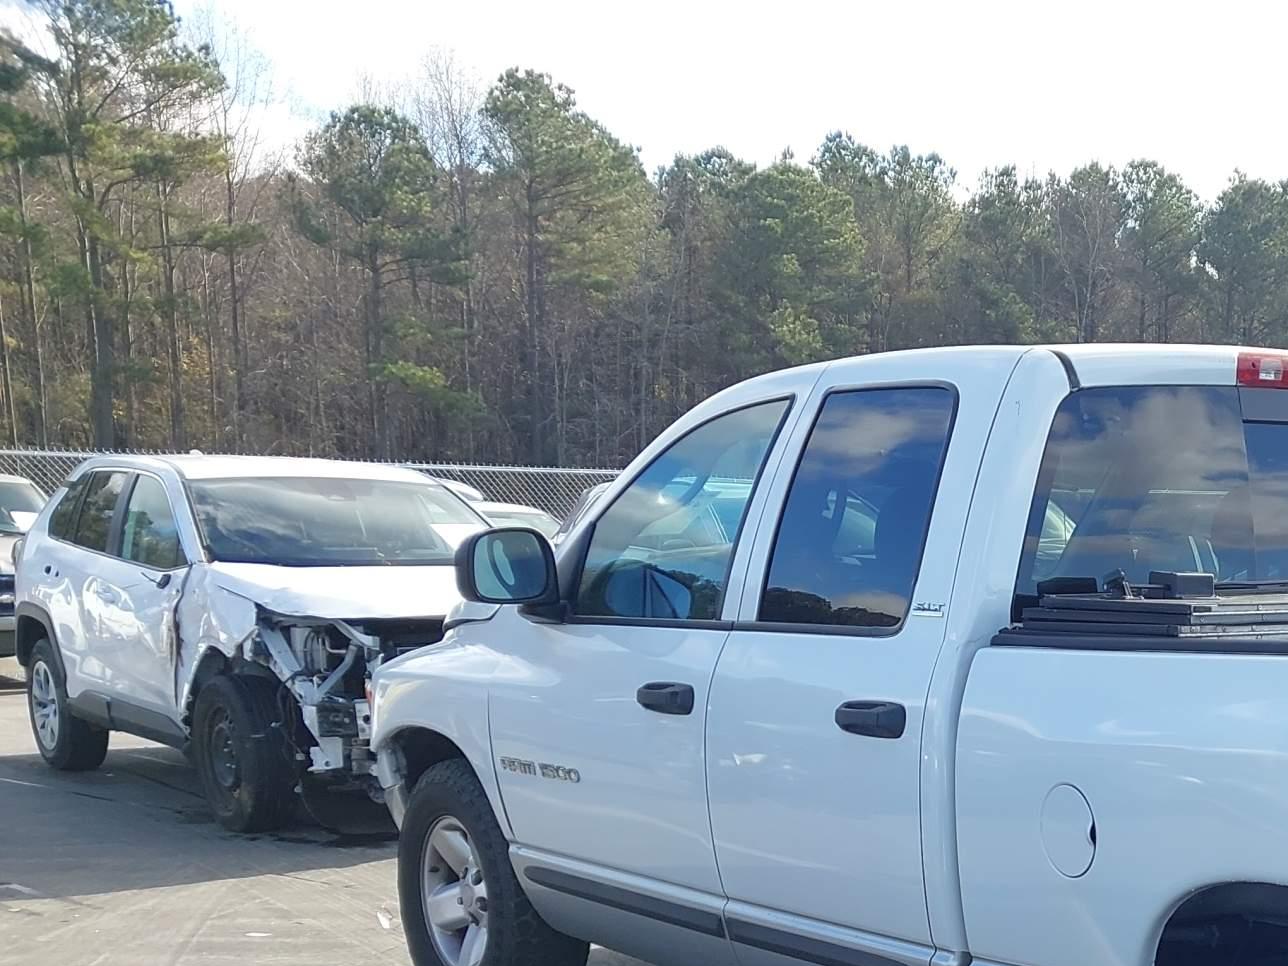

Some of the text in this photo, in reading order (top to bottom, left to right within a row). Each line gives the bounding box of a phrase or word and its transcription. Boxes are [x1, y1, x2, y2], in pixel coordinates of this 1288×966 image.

[912, 601, 946, 613] SLT
[499, 756, 581, 783] RAM 1500
